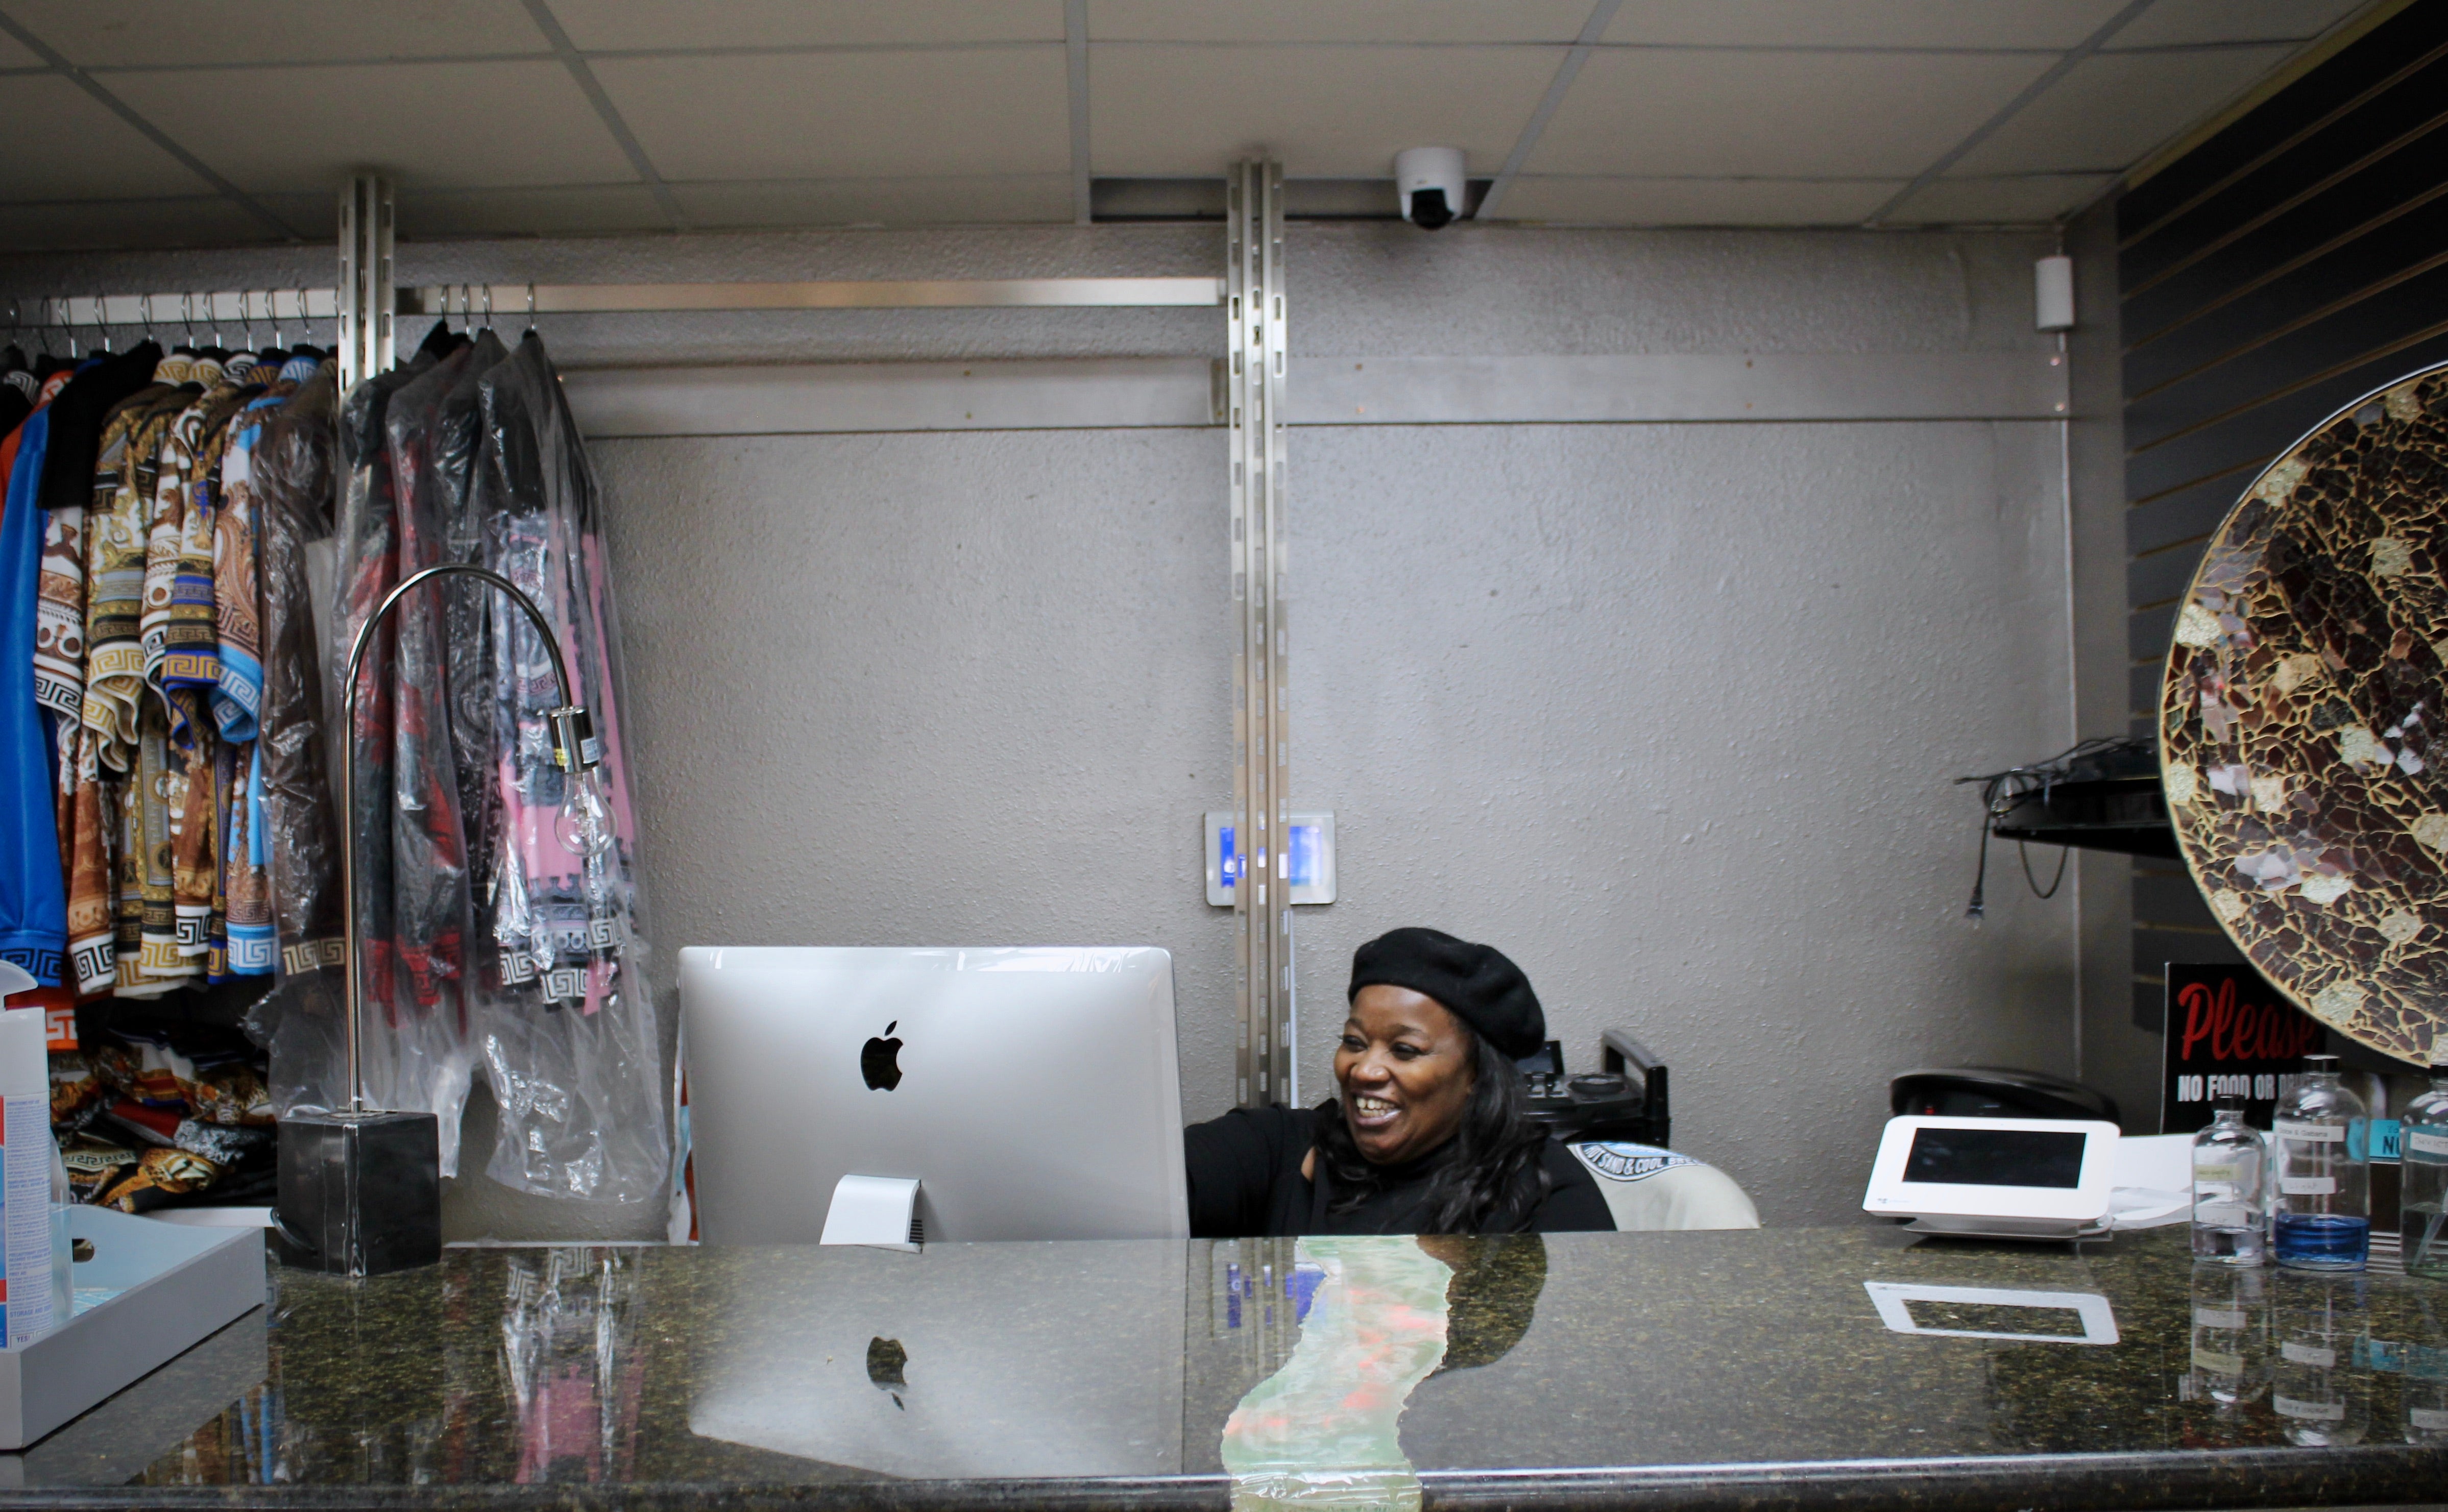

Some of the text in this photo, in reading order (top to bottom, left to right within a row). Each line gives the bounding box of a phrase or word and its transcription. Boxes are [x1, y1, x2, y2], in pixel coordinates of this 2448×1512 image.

[2178, 977, 2318, 1061] Please
[2177, 1075, 2203, 1102] NO
[2207, 1075, 2251, 1101] FOOD
[2254, 1075, 2275, 1100] OR
[1584, 1145, 1606, 1162] HOT
[1598, 1153, 1625, 1175] SAND
[1623, 1158, 1634, 1176] &
[1635, 1156, 1664, 1174] COOL
[10, 1309, 33, 1318] STORAGE
[17, 1335, 30, 1343] YES!
